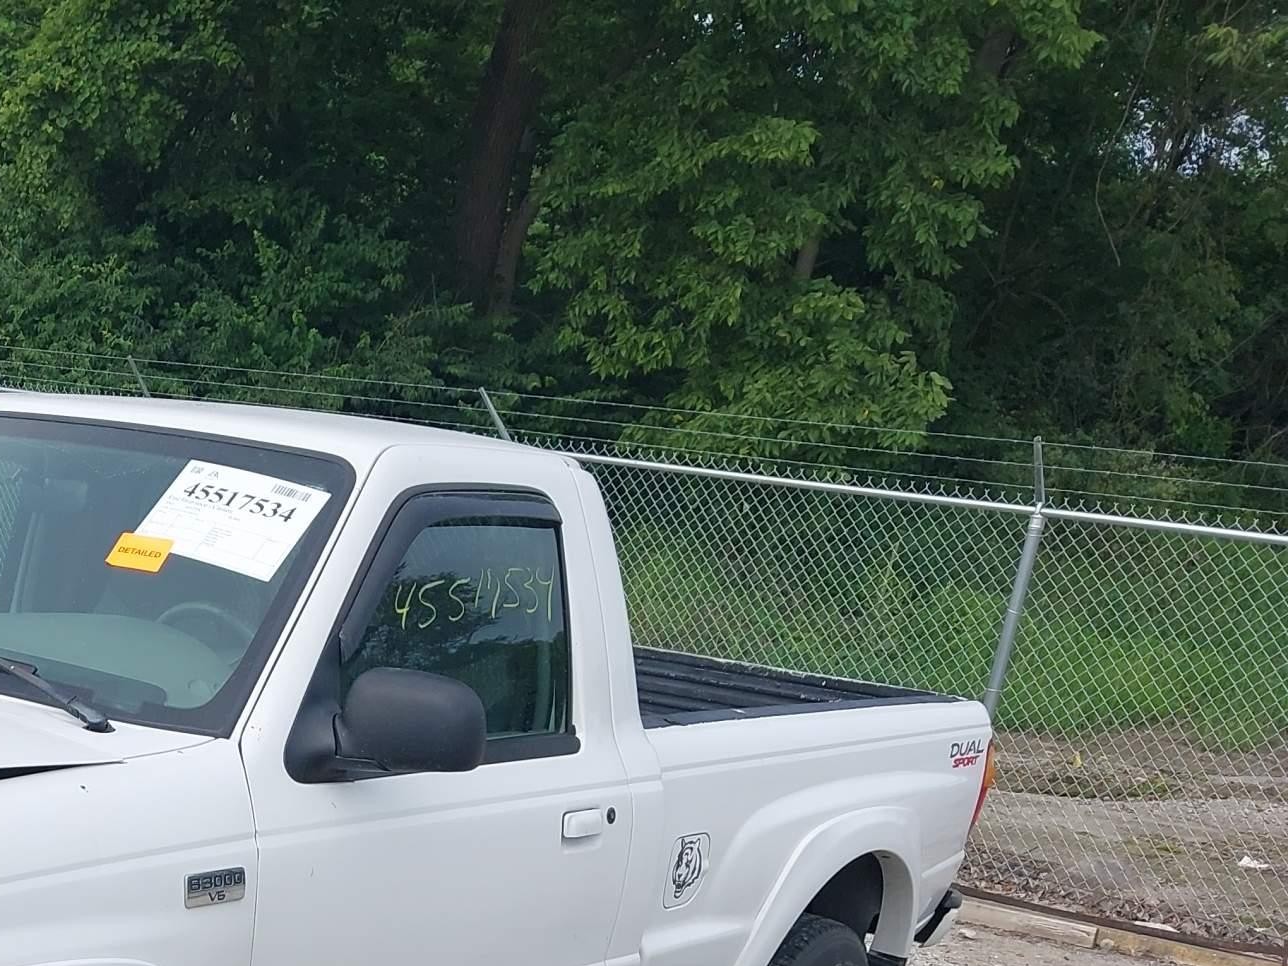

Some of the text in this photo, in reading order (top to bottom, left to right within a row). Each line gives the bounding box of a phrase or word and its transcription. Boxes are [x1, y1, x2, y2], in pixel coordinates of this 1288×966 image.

[183, 482, 298, 523] 45517534
[117, 545, 162, 560] DETAILED
[950, 739, 984, 759] DUAL
[952, 755, 980, 768] SPORT
[190, 872, 243, 891] B3000
[208, 890, 226, 902] V6
